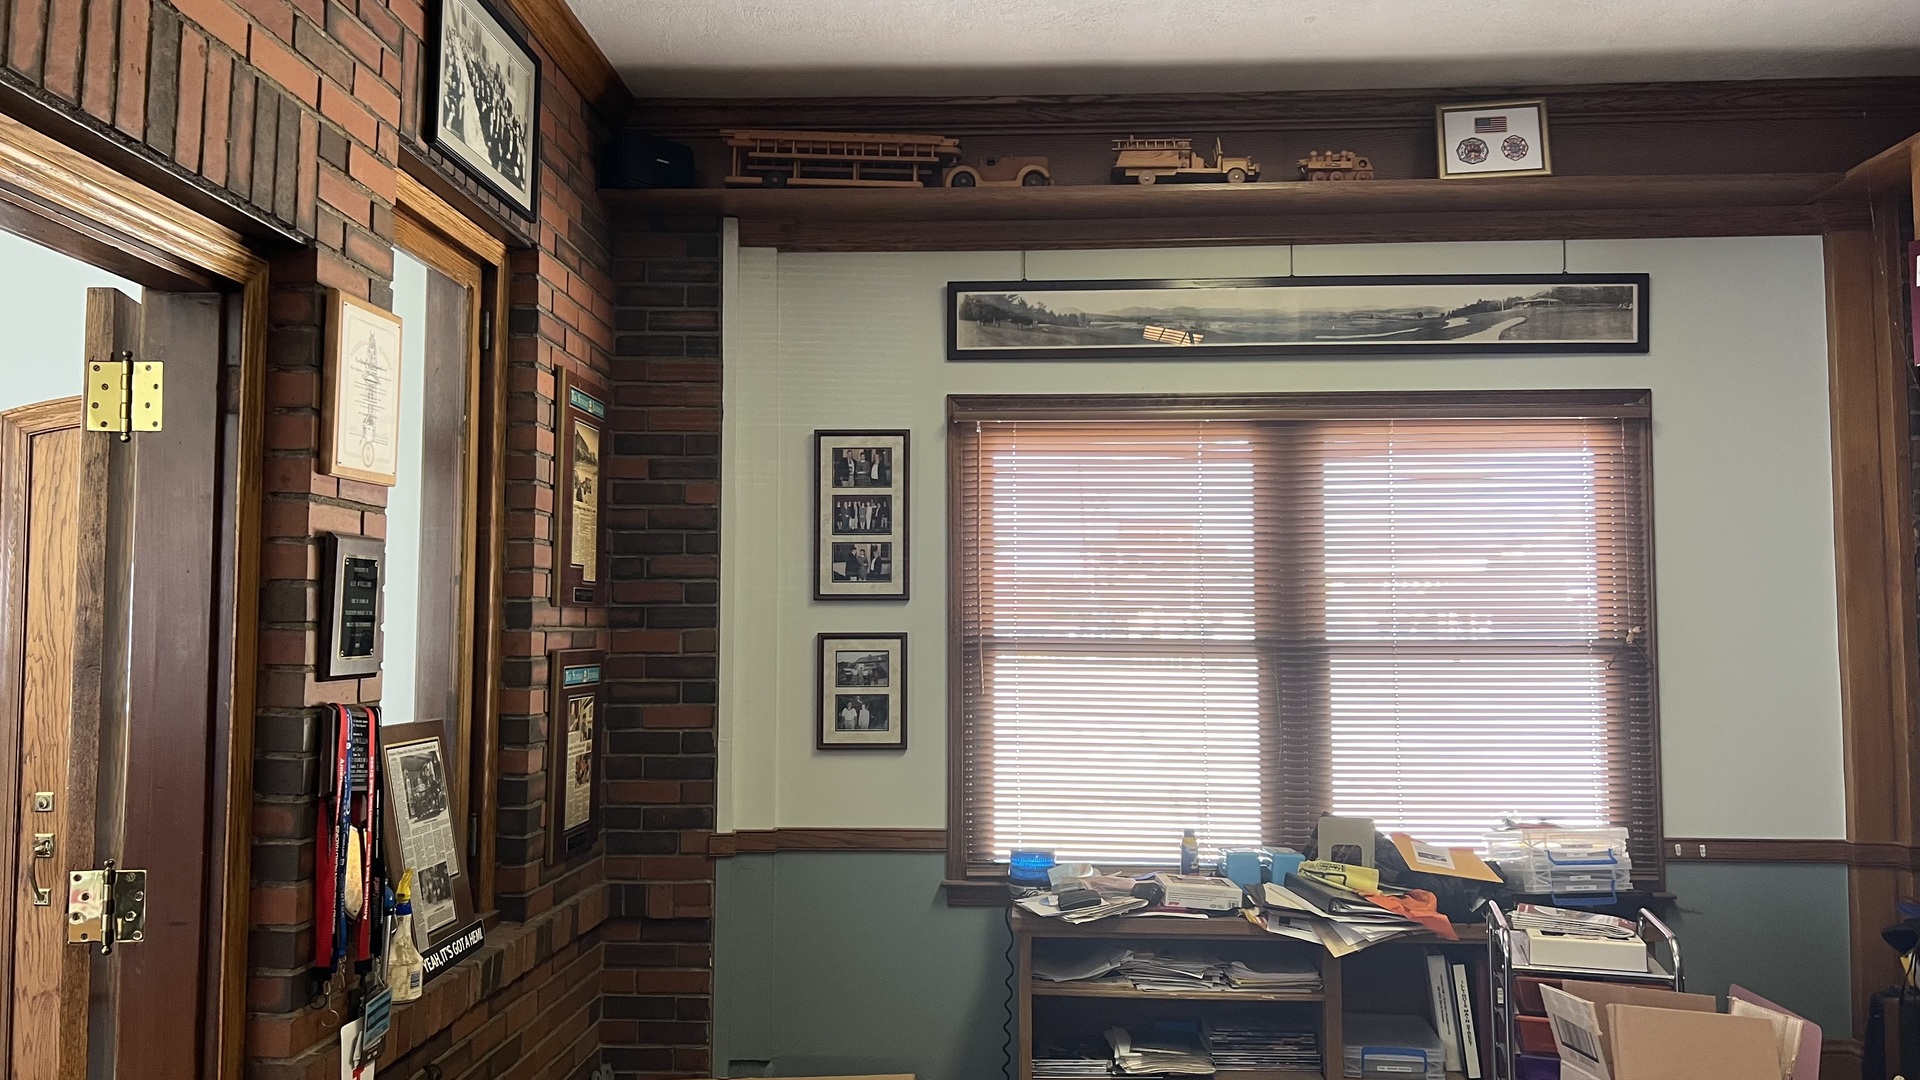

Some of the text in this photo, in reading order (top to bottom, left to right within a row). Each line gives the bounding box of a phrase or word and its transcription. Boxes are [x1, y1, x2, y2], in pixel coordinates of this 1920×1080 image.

[423, 952, 443, 973] YEAH,
[439, 945, 454, 963] IT'S
[452, 937, 465, 955] GOT
[464, 935, 471, 949] A
